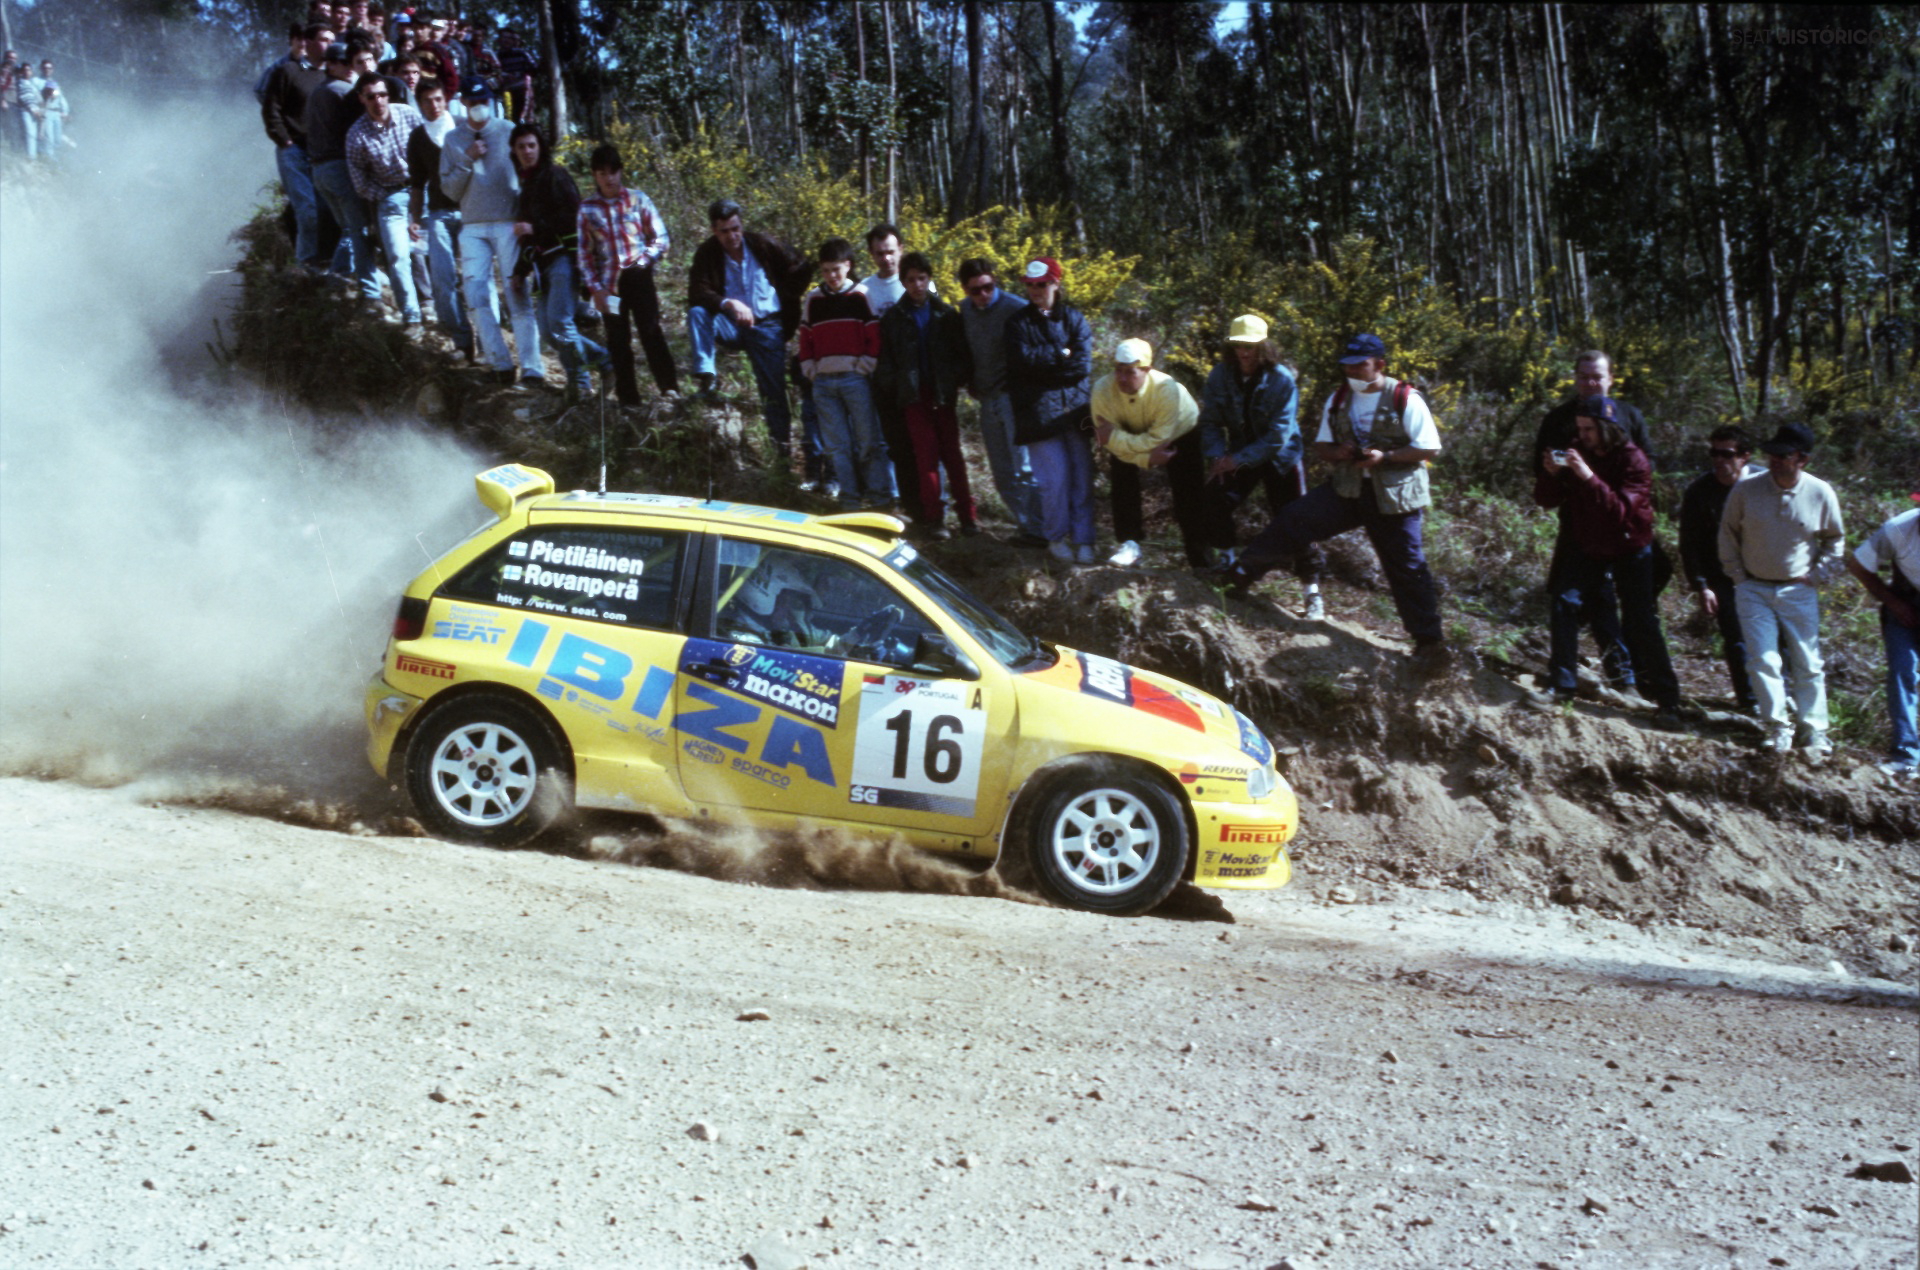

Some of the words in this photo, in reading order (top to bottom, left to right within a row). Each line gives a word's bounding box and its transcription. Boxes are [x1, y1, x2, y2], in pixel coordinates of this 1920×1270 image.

[530, 540, 644, 576] Pietiläinen
[524, 563, 639, 600] Rovanperä
[497, 593, 523, 606] http:
[602, 611, 627, 621] com
[432, 621, 507, 644] SEAT
[396, 654, 457, 680] PIRELLI
[751, 655, 840, 698] MoviStar
[506, 618, 838, 788] IBIZA
[727, 677, 740, 688] by
[744, 674, 839, 723] maxon
[918, 689, 959, 701] PORTUGAL
[971, 687, 982, 710] A
[886, 709, 964, 784] 16
[731, 757, 792, 788] sparco
[1203, 764, 1248, 776] REPSOL
[850, 785, 879, 804] SG
[1219, 823, 1287, 843] PIRELLI
